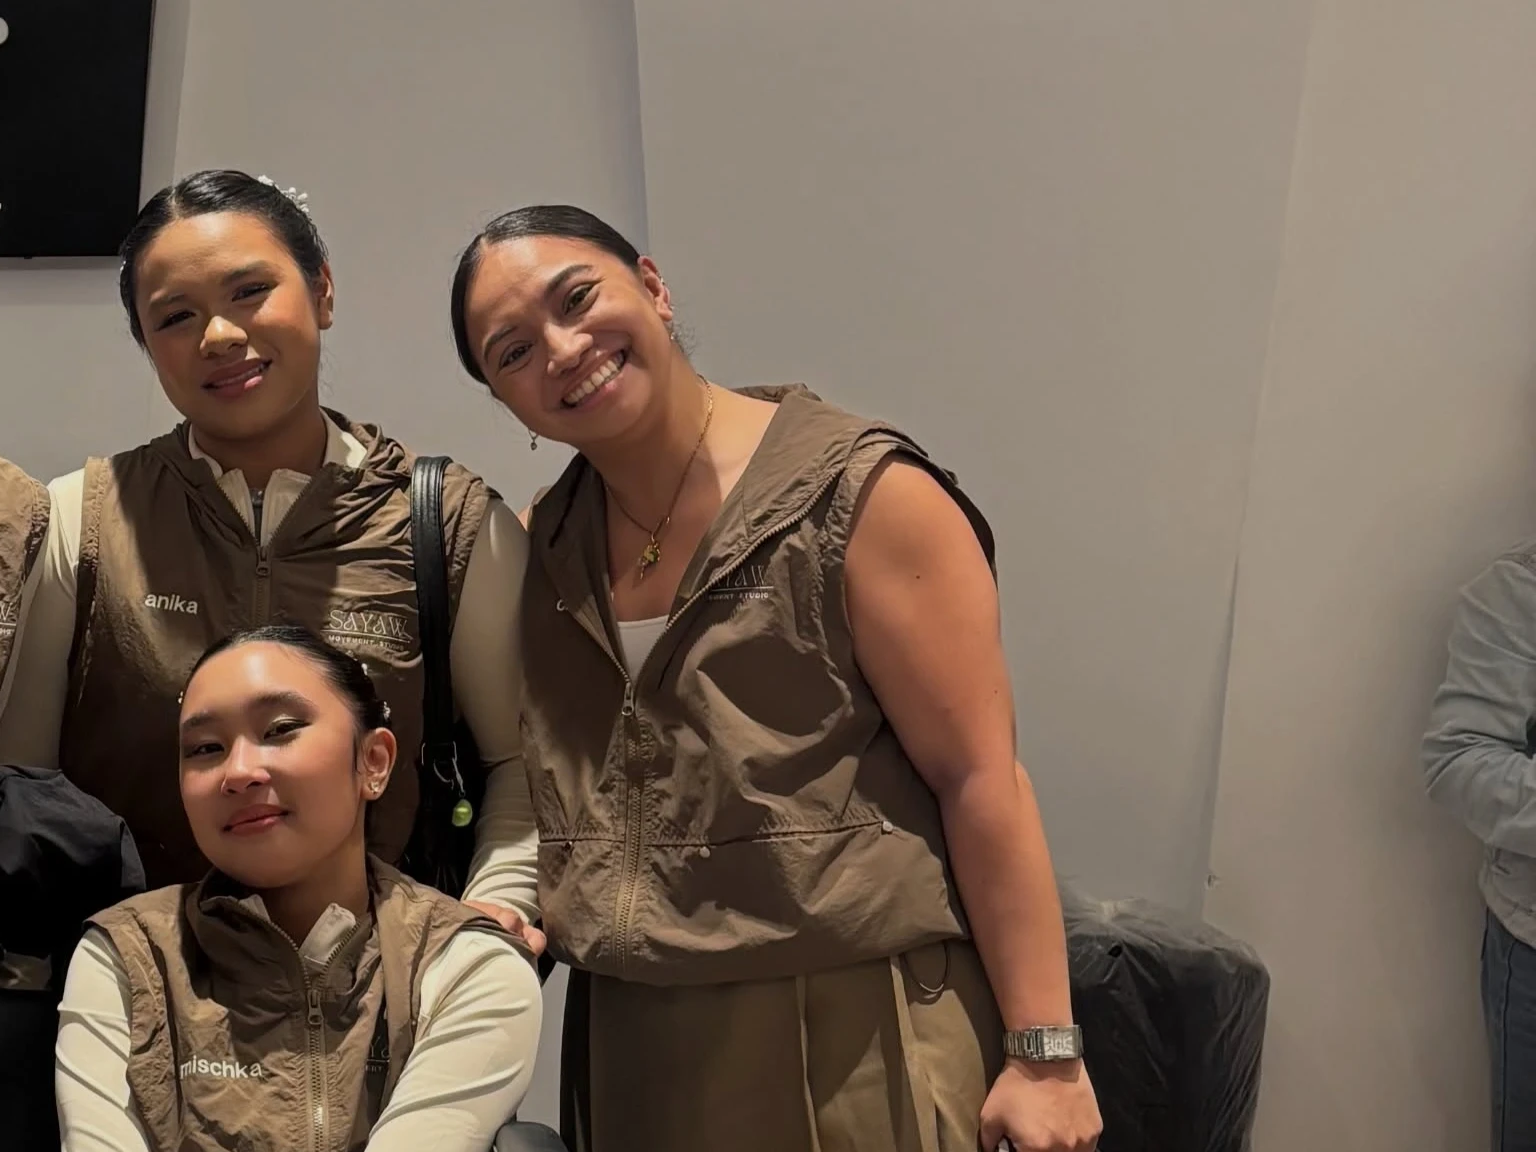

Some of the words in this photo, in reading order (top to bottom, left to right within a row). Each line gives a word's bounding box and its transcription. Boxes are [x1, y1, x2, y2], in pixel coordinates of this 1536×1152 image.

[144, 592, 199, 615] anika
[328, 609, 409, 638] SAYAW
[179, 1055, 263, 1079] mischka
